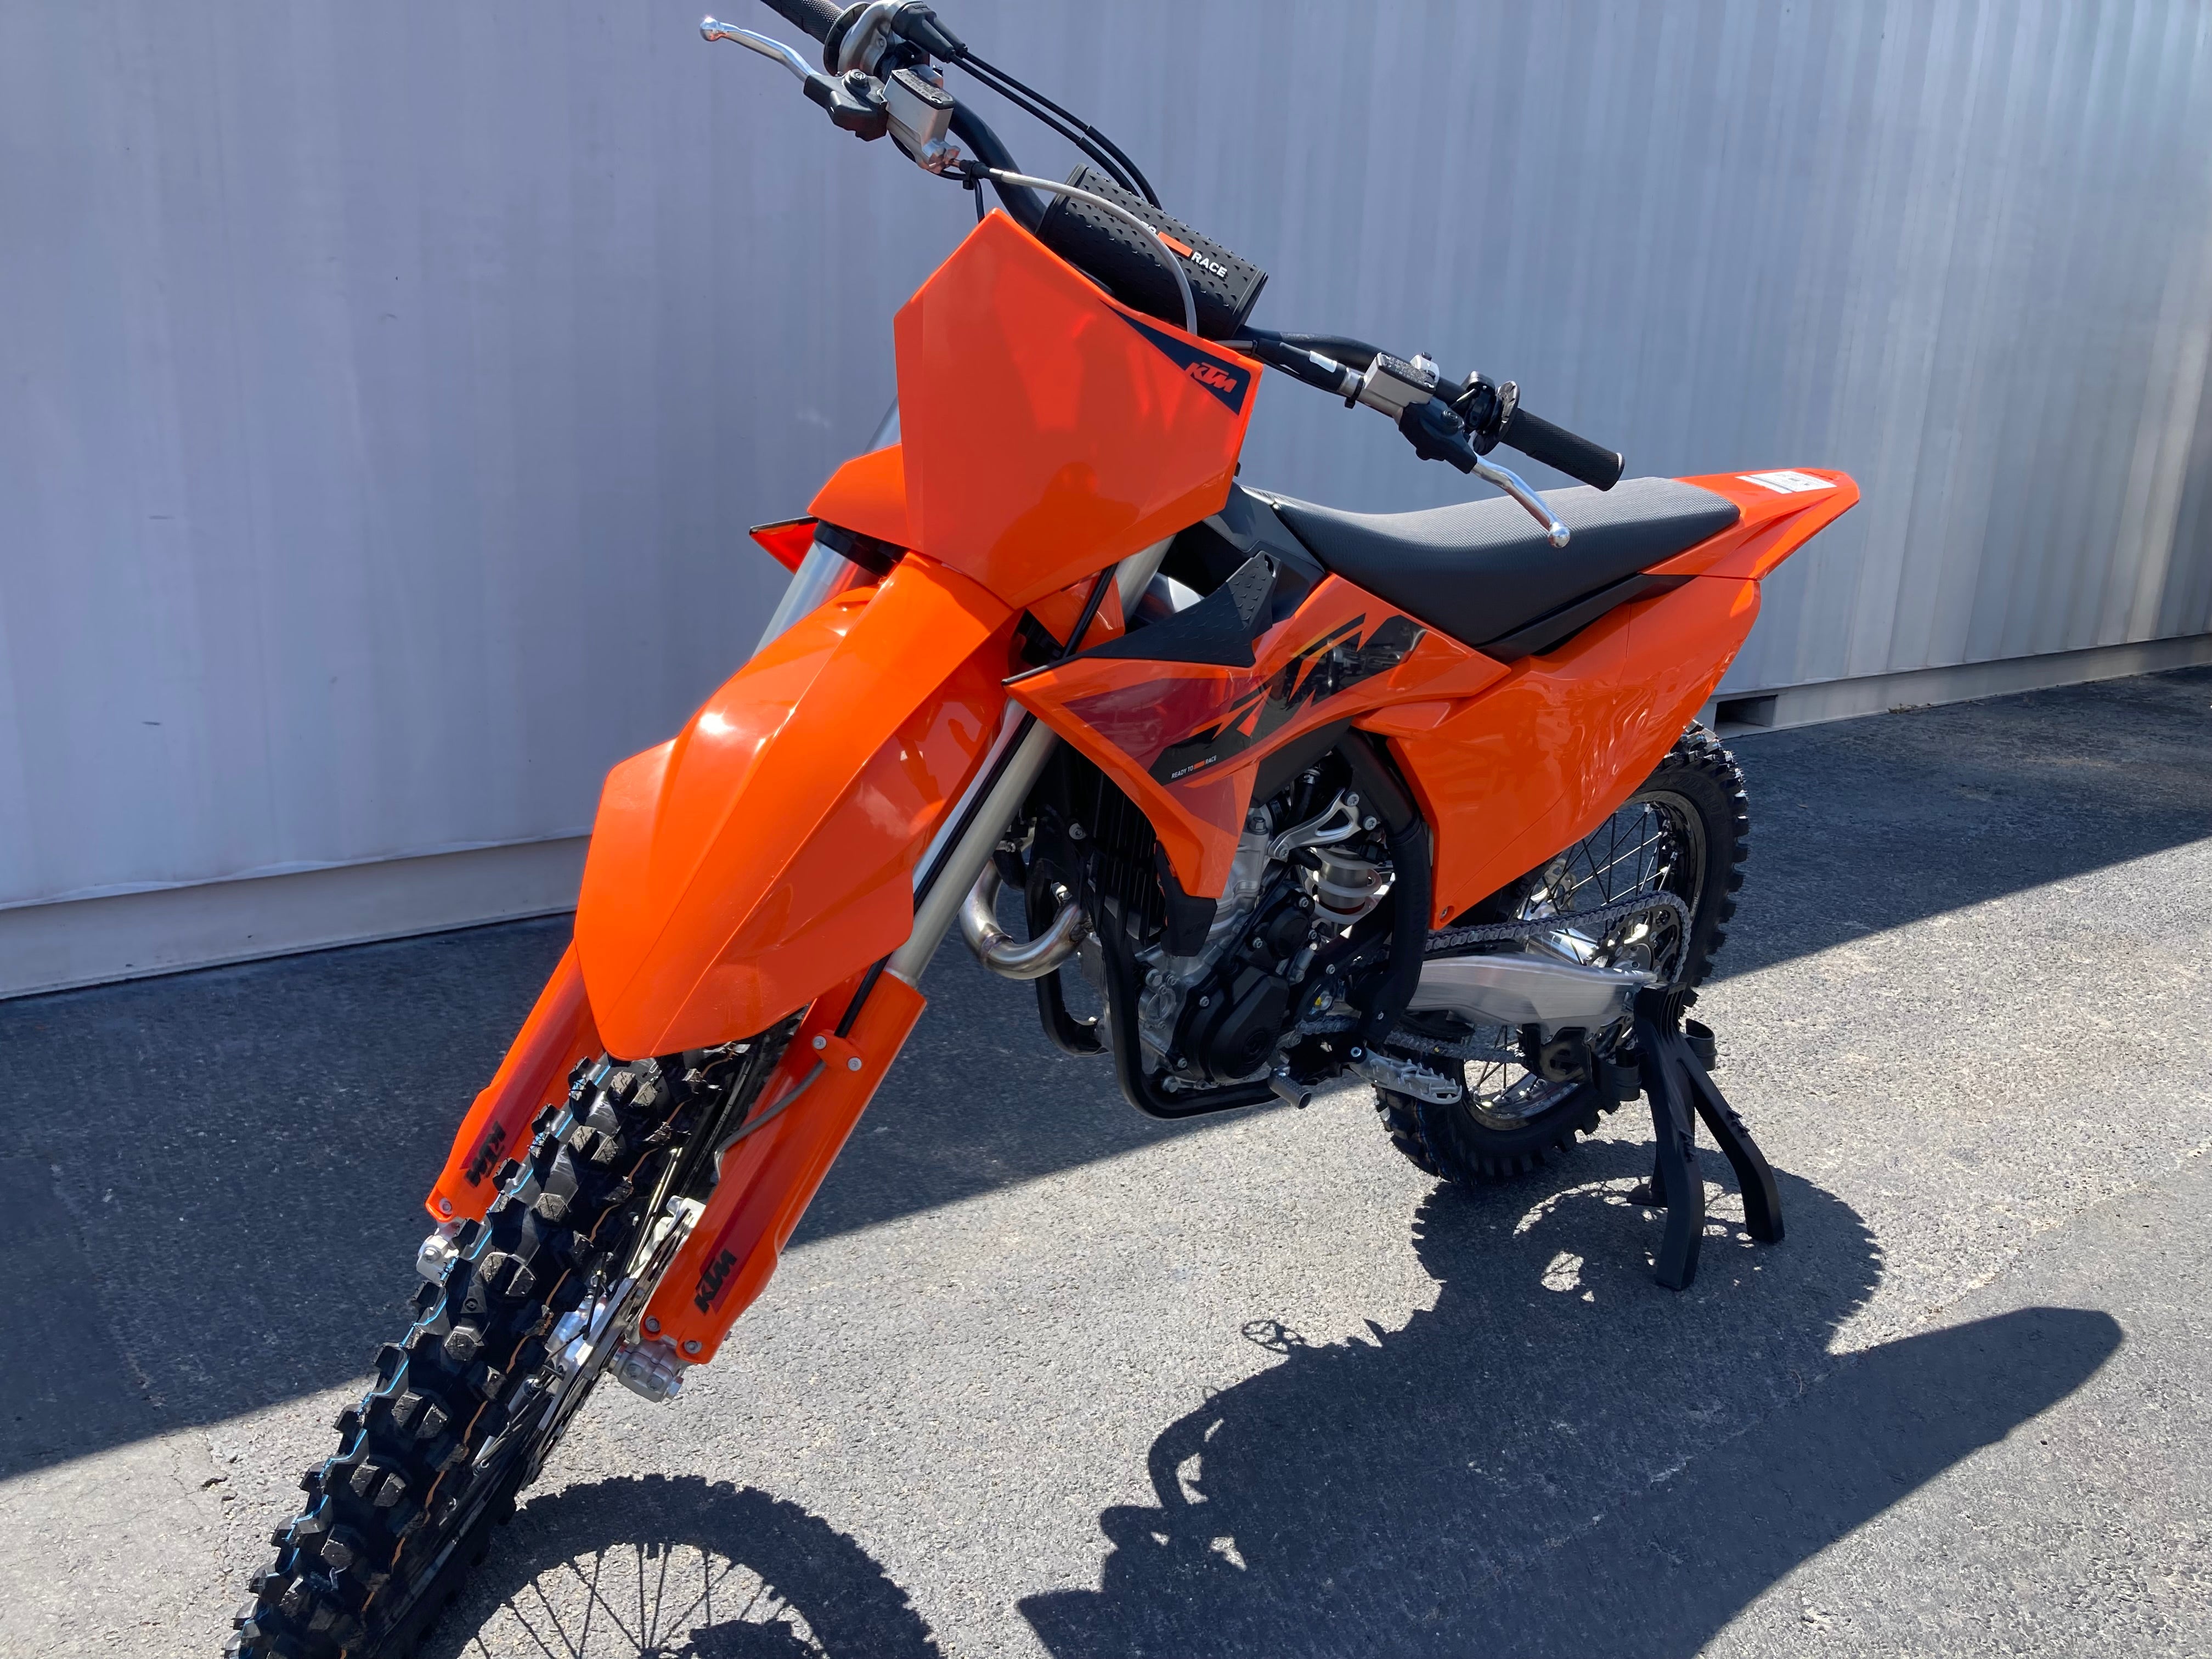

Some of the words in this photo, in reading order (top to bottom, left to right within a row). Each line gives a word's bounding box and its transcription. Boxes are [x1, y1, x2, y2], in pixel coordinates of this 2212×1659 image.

[1191, 251, 1227, 278] RACE
[1185, 362, 1237, 393] KTM
[1171, 768, 1187, 778] READY
[1205, 755, 1217, 764] RACE
[465, 1120, 506, 1187] KTM
[695, 1249, 737, 1314] KTM
